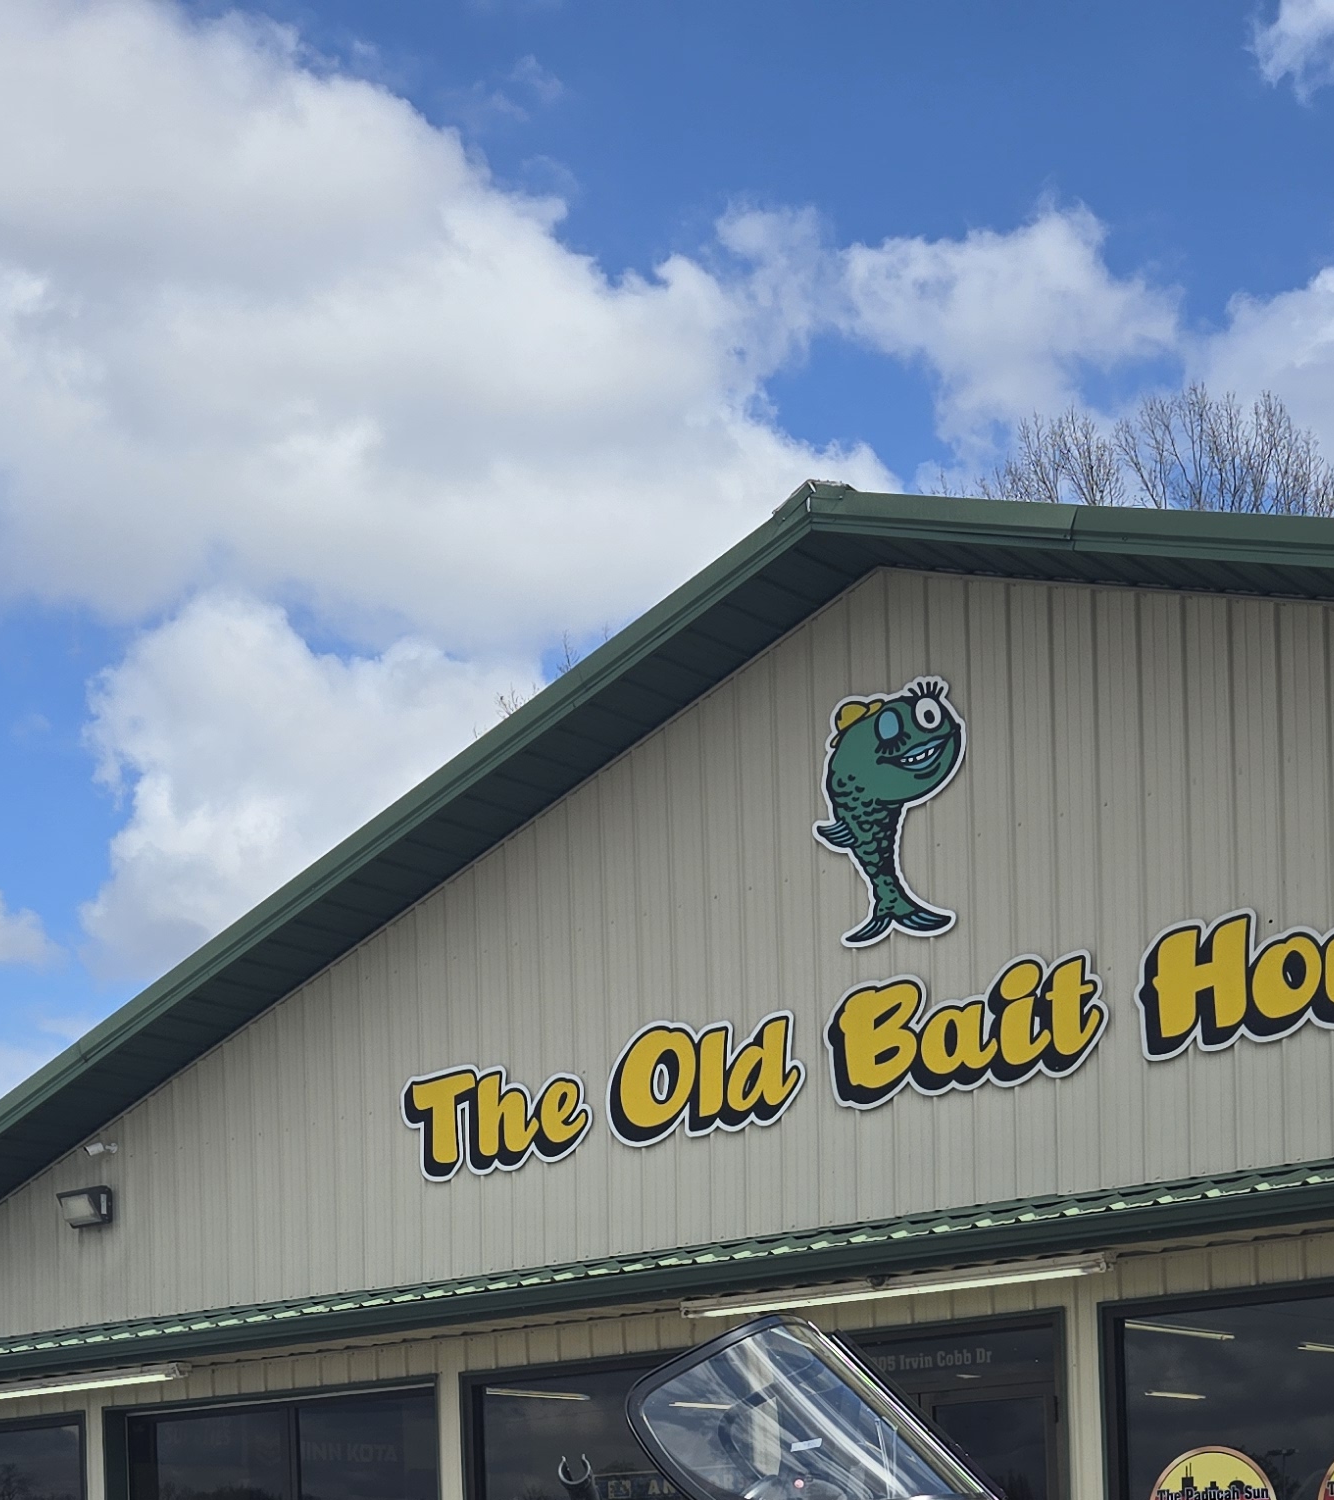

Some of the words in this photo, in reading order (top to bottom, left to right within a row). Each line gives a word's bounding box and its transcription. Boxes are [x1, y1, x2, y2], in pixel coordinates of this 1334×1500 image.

[405, 1068, 589, 1179] The
[612, 1014, 803, 1144] Old
[828, 953, 1106, 1107] Bait
[900, 1353, 933, 1370] Irvin
[937, 1349, 971, 1367] Cobb
[976, 1348, 992, 1363] Dr
[1244, 1484, 1269, 1500] Sun
